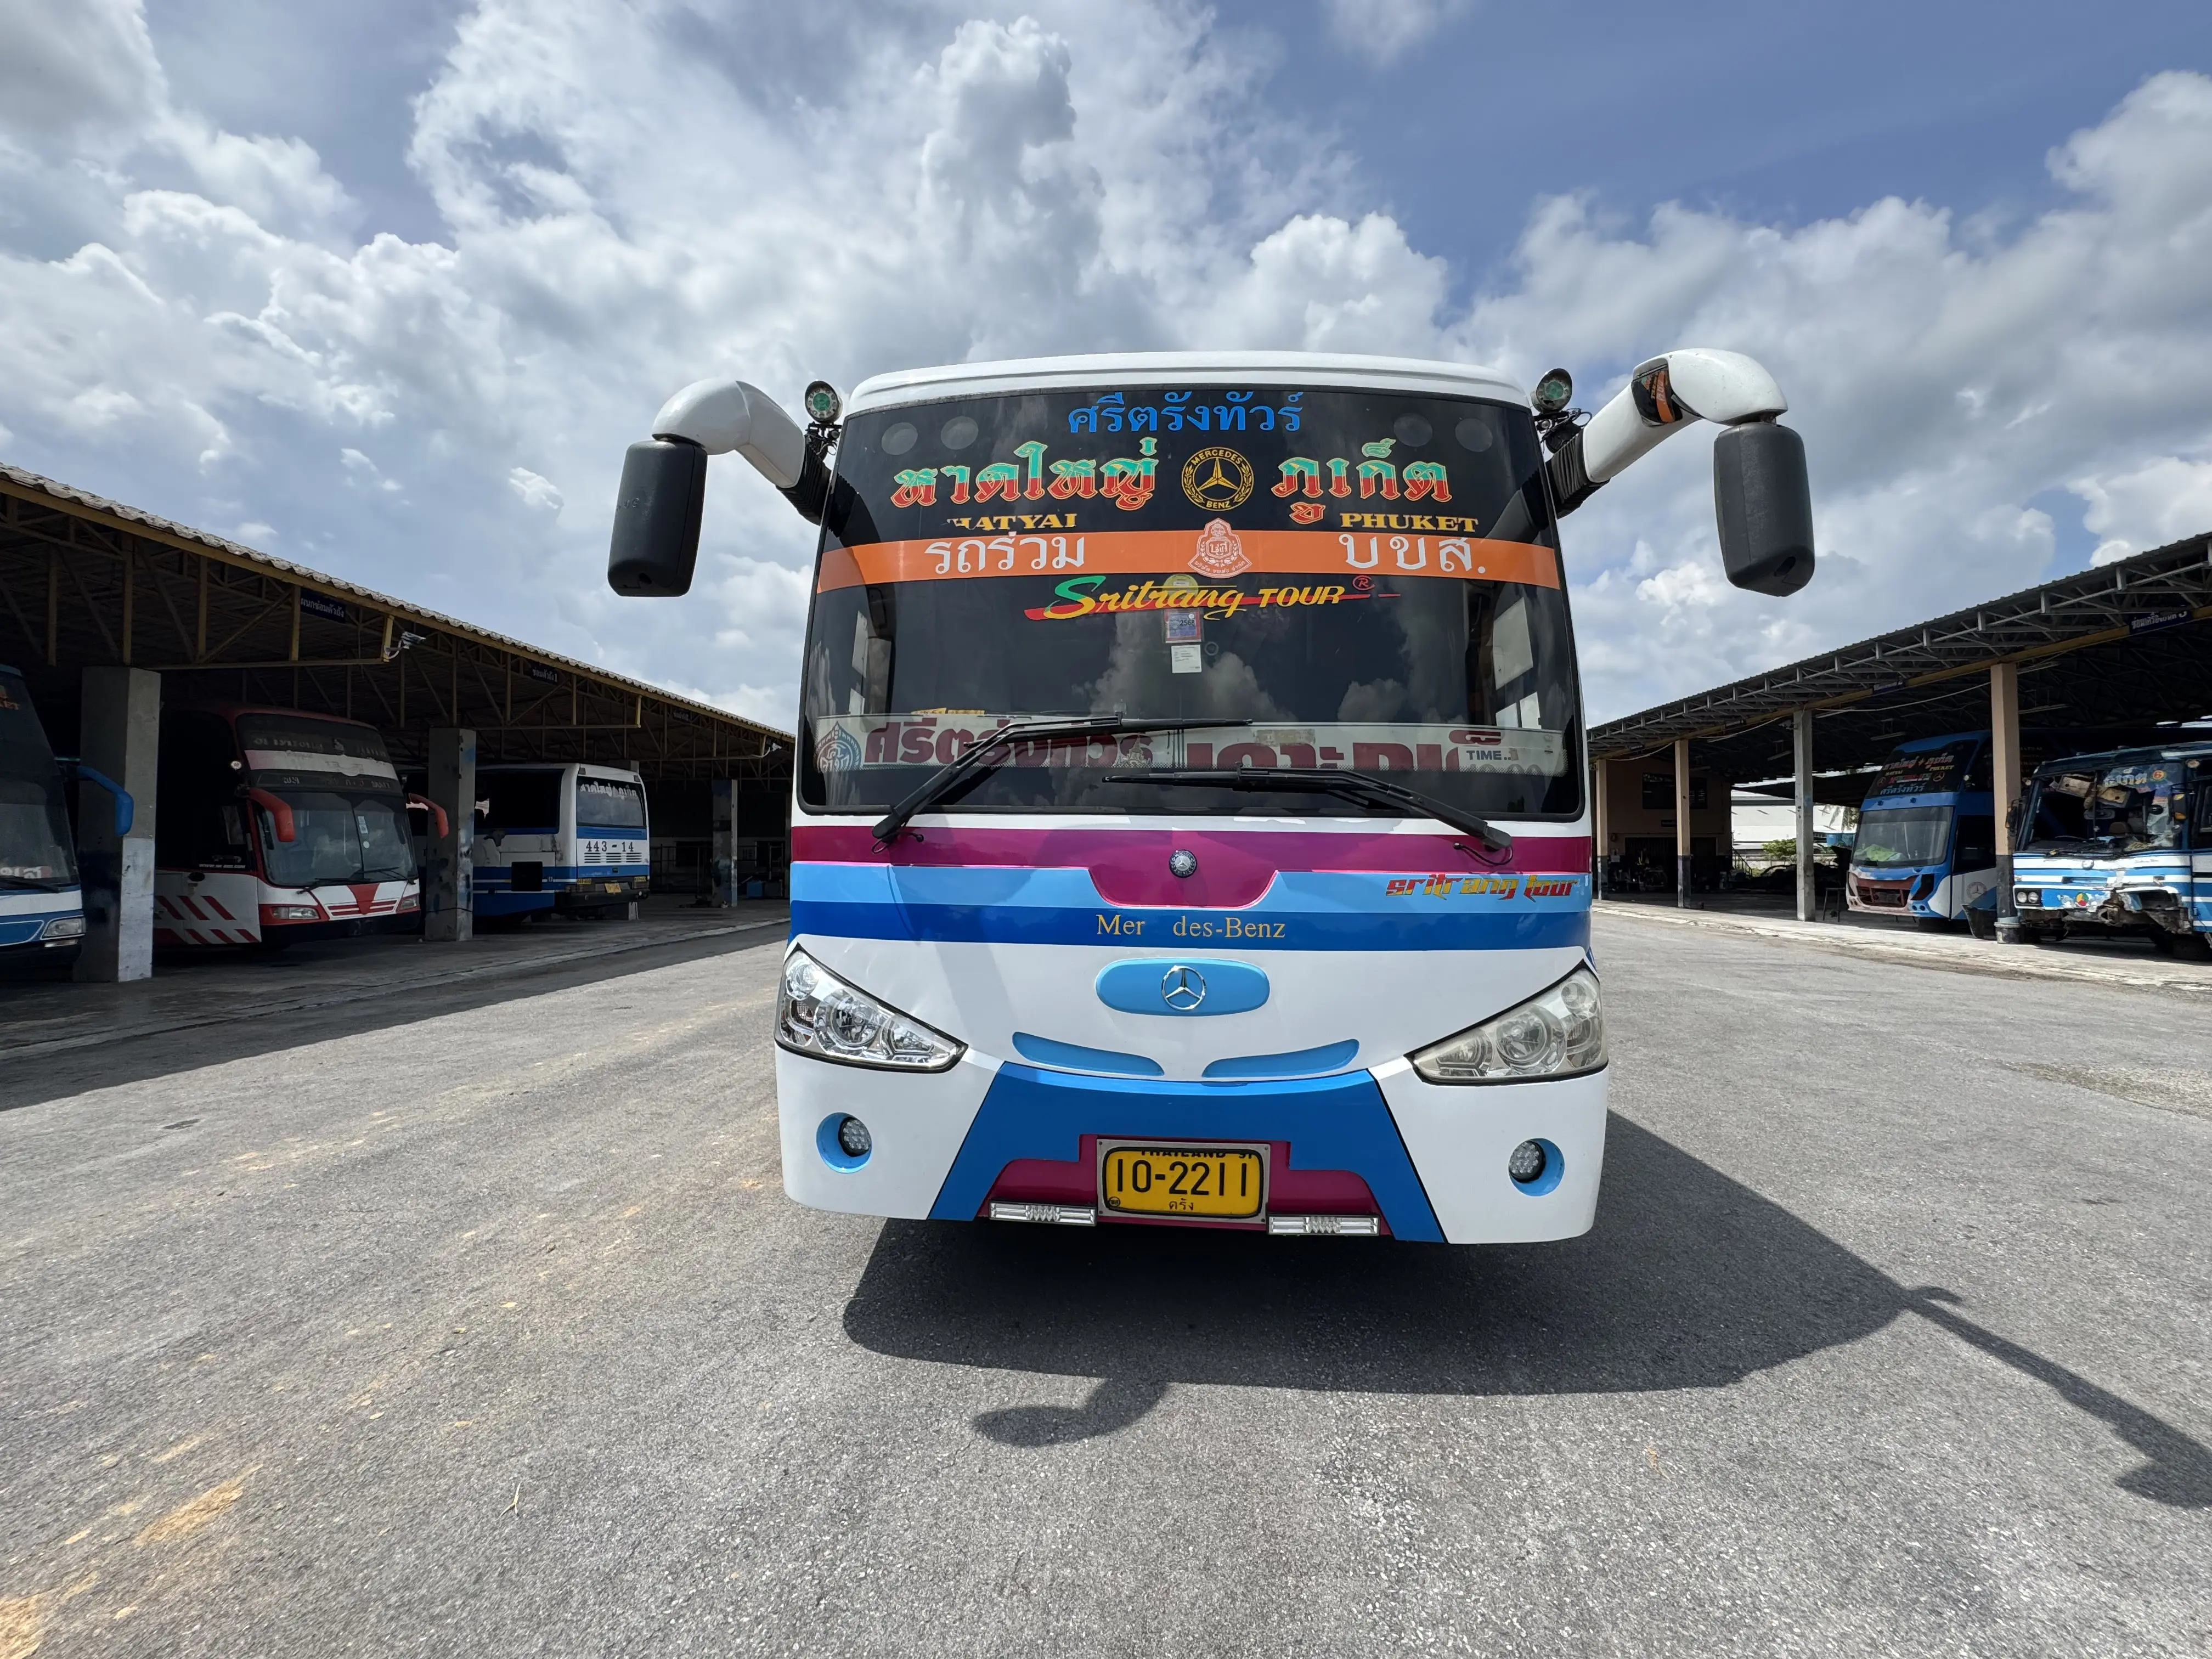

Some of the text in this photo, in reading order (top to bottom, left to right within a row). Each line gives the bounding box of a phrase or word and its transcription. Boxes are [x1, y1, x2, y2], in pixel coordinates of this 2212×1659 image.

[1068, 391, 1304, 433] ศรีตรังทัวร์
[889, 437, 1159, 511] หาดใหญ่
[1190, 449, 1243, 466] MERCEDES
[1270, 438, 1453, 524] ภูเก็ต
[1206, 500, 1231, 509] BENZ
[1339, 512, 1479, 533] PHUKET
[924, 531, 1086, 574] รถร่วม
[1043, 575, 1246, 620] Sritrang
[1257, 585, 1345, 606] TOUR
[586, 840, 607, 852] 443
[622, 841, 634, 852] 14
[1117, 1158, 1248, 1197] 10-2211
[1169, 1197, 1195, 1211] ตรัง
